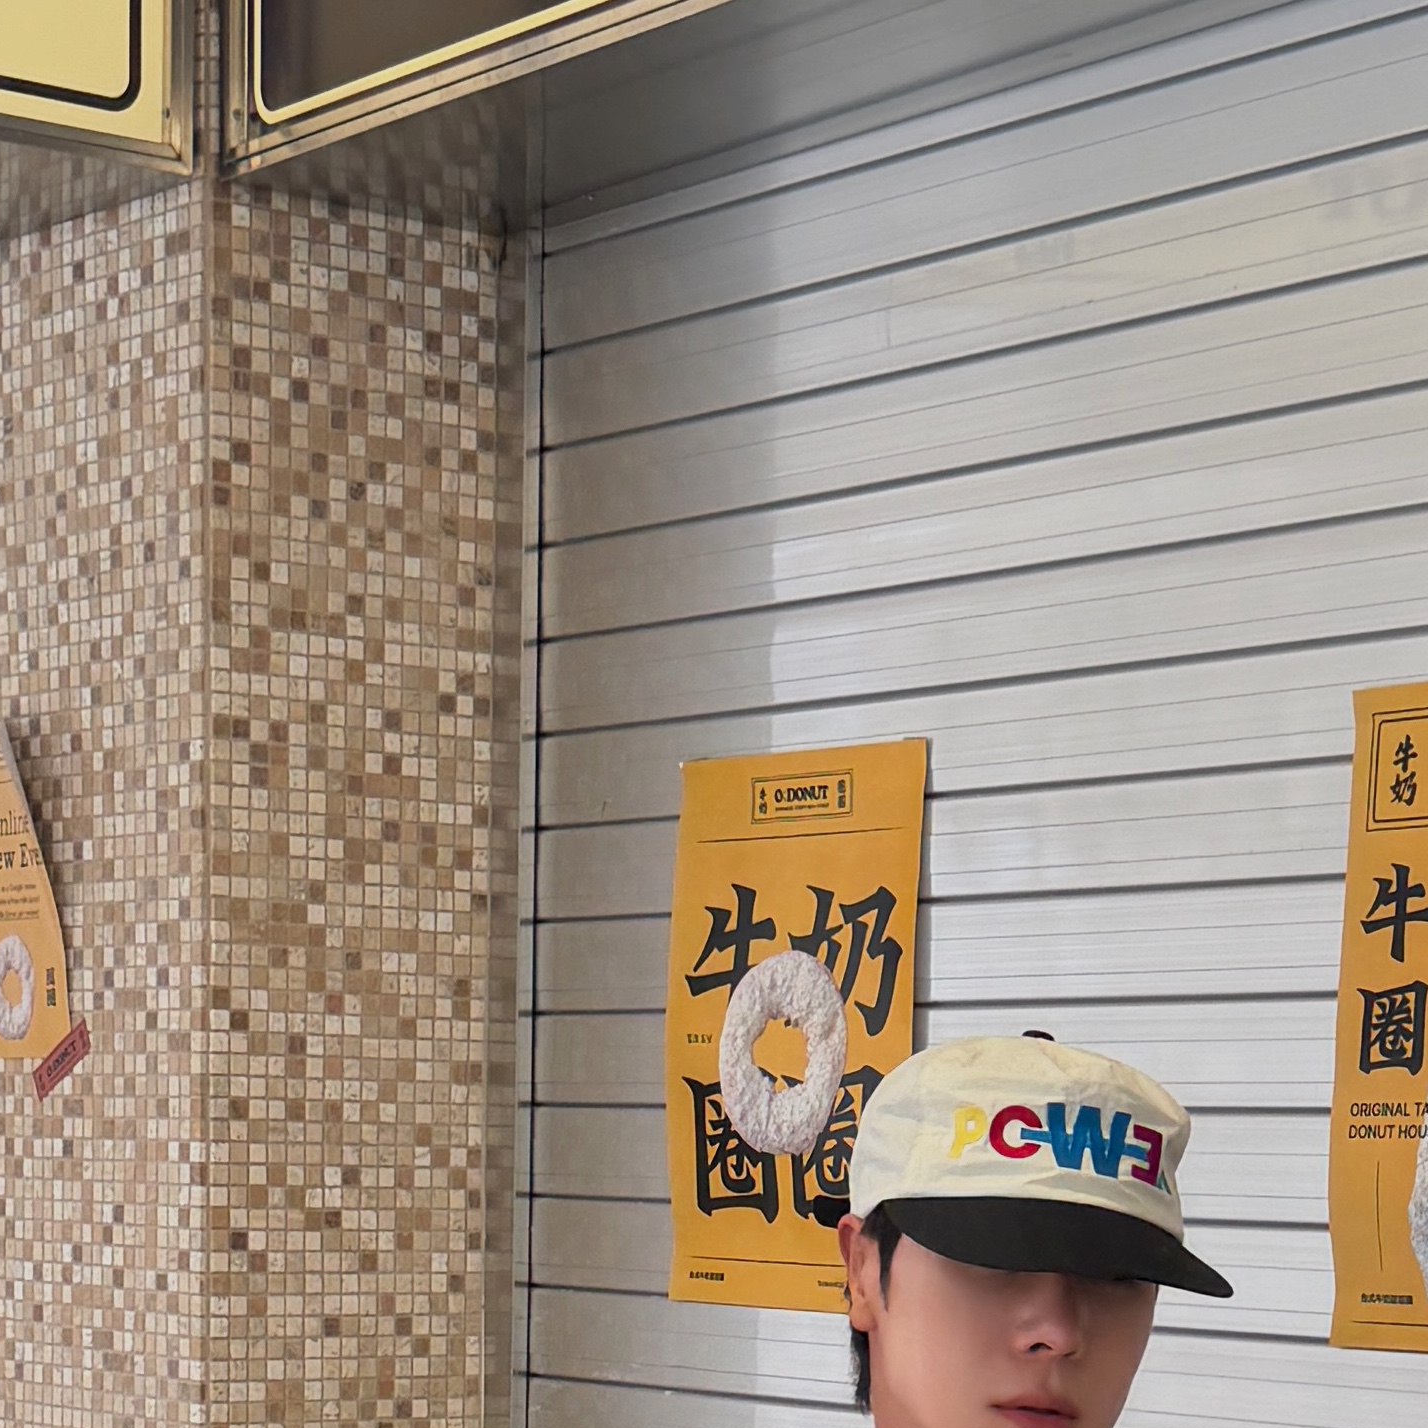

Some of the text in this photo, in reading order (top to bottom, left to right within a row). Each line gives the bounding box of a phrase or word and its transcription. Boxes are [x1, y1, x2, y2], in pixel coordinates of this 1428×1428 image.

[1389, 733, 1418, 807] 牛奶
[684, 883, 904, 1037] 牛奶
[1348, 1124, 1395, 1139] DONUT
[1350, 1102, 1411, 1118] ORIGINAL
